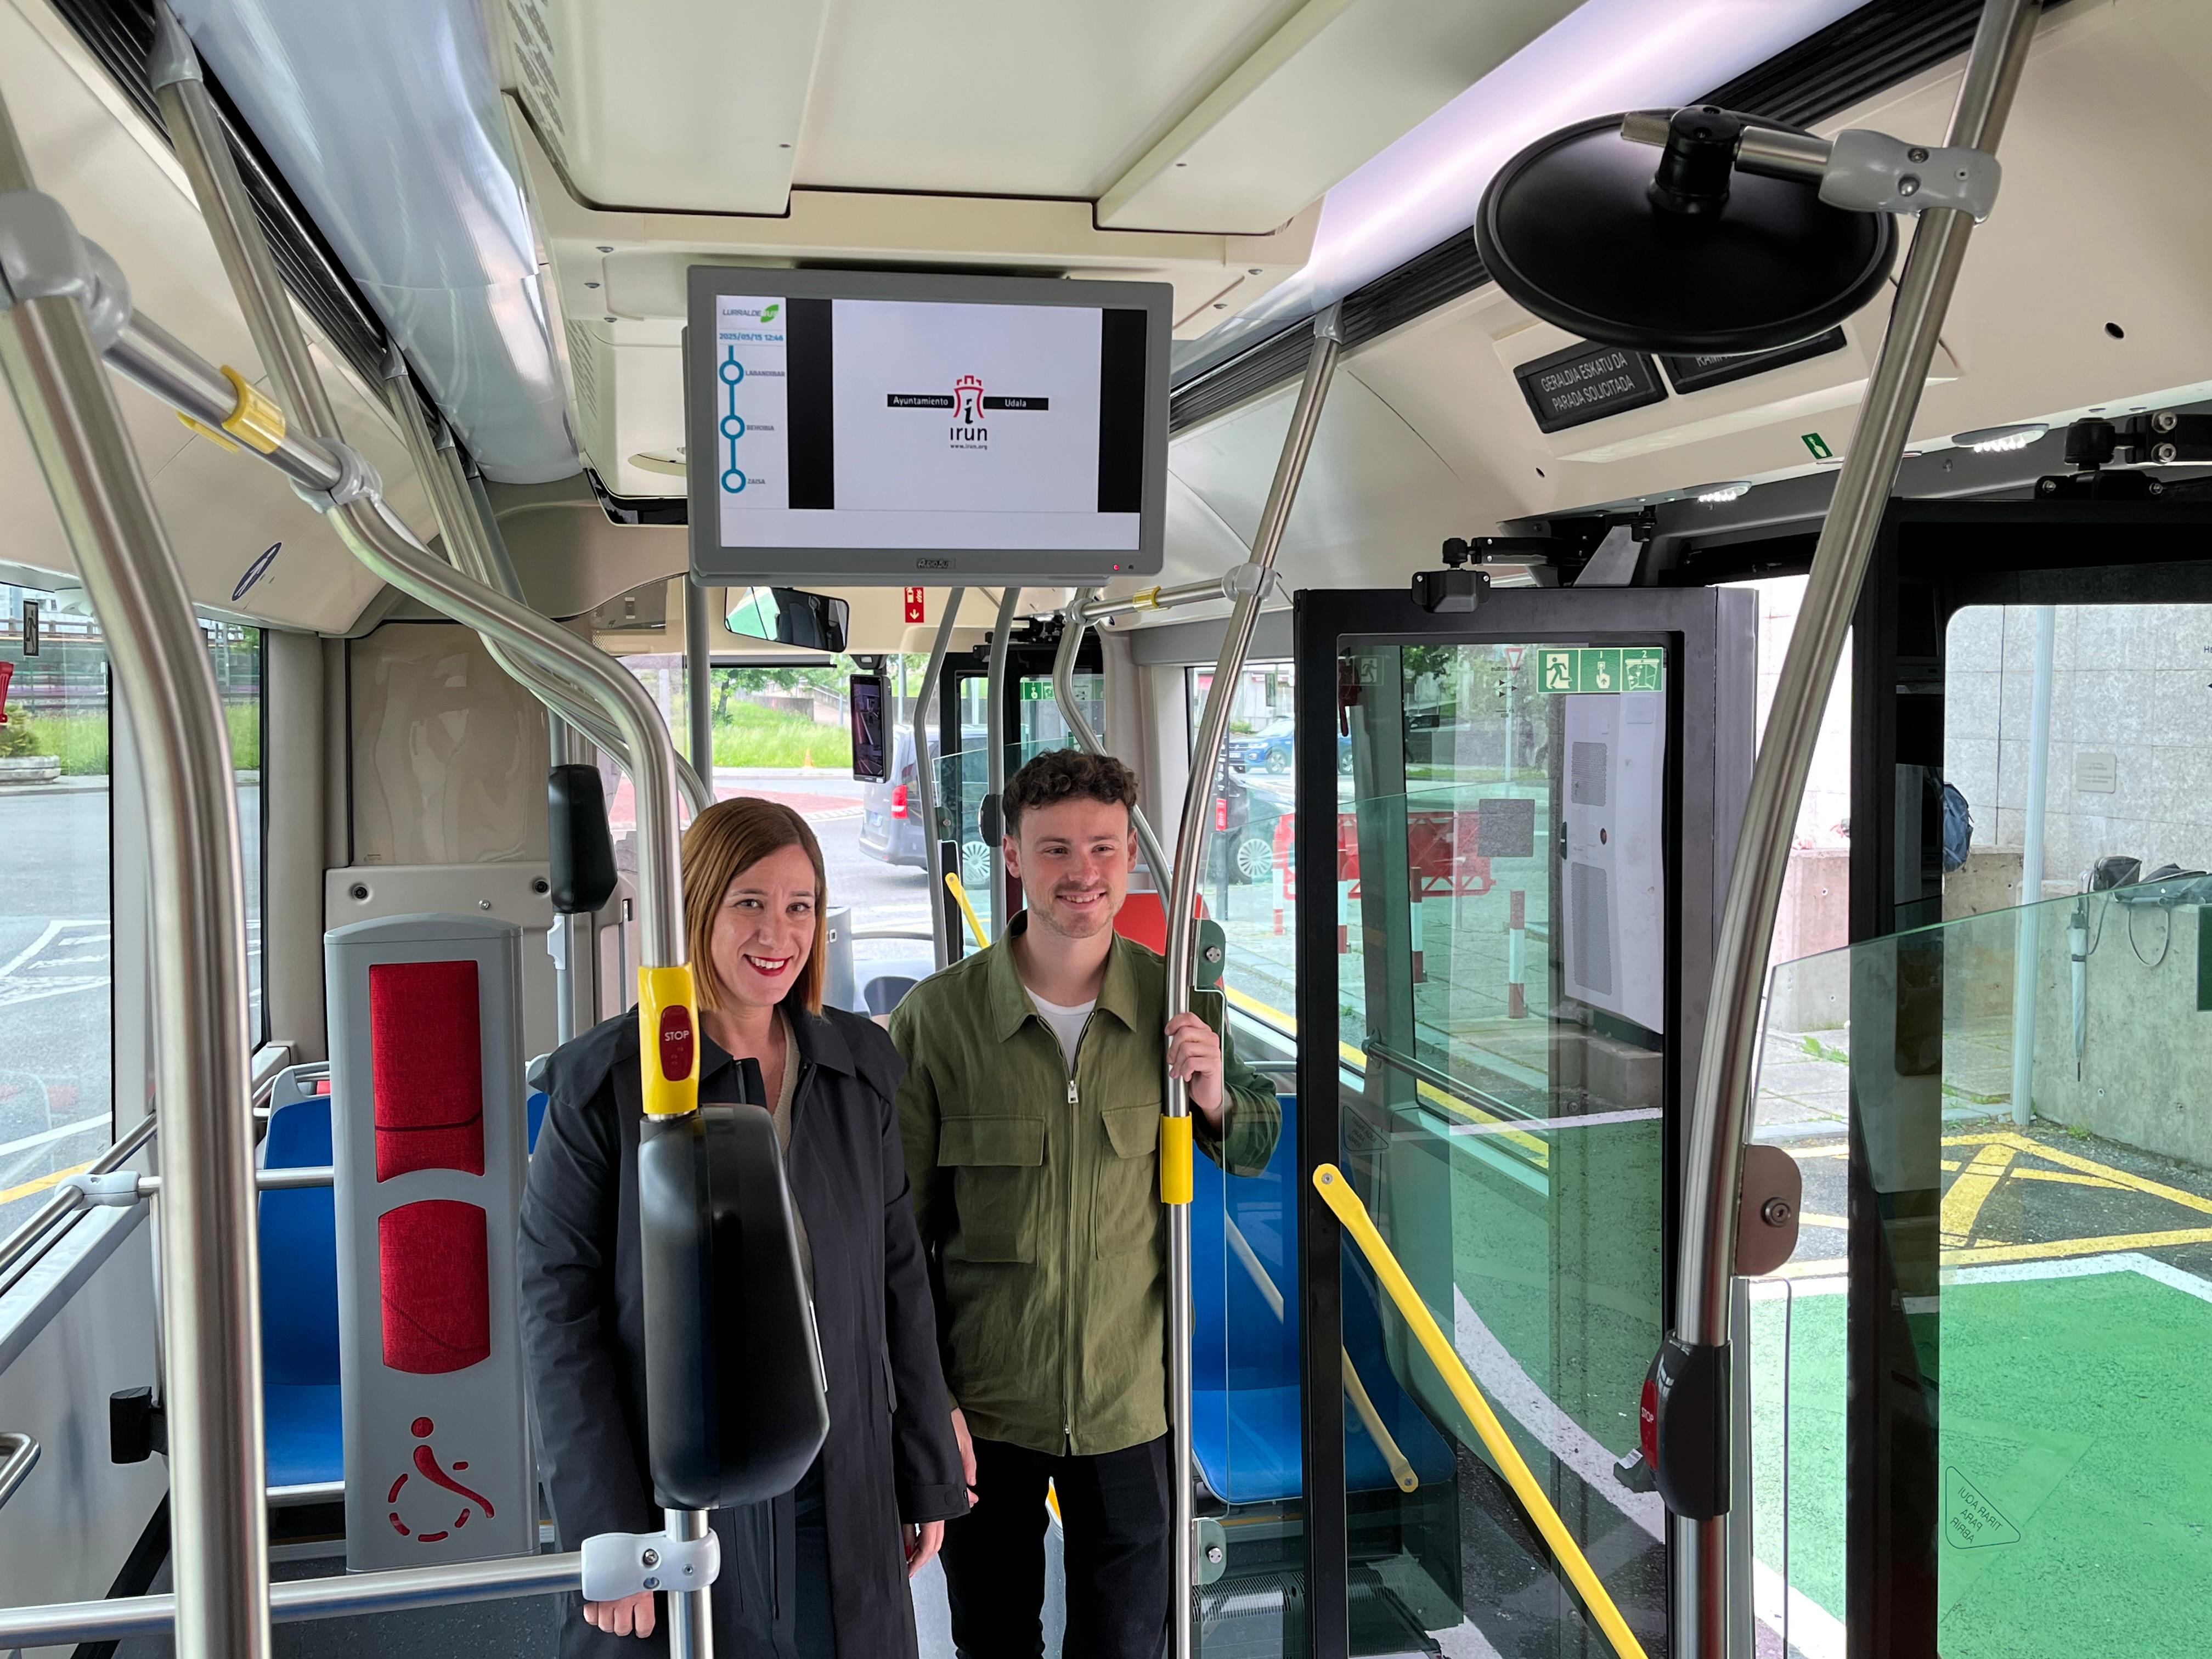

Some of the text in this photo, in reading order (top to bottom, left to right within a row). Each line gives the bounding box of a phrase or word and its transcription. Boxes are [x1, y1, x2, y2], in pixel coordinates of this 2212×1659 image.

[1541, 352, 1628, 392] GERALDIA ESKATU DA
[1552, 374, 1635, 411] PARADA SOLICITADA
[893, 396, 1026, 408] Ayuntamiento Udala
[664, 1030, 690, 1041] STOP
[1641, 1407, 1654, 1423] STOP
